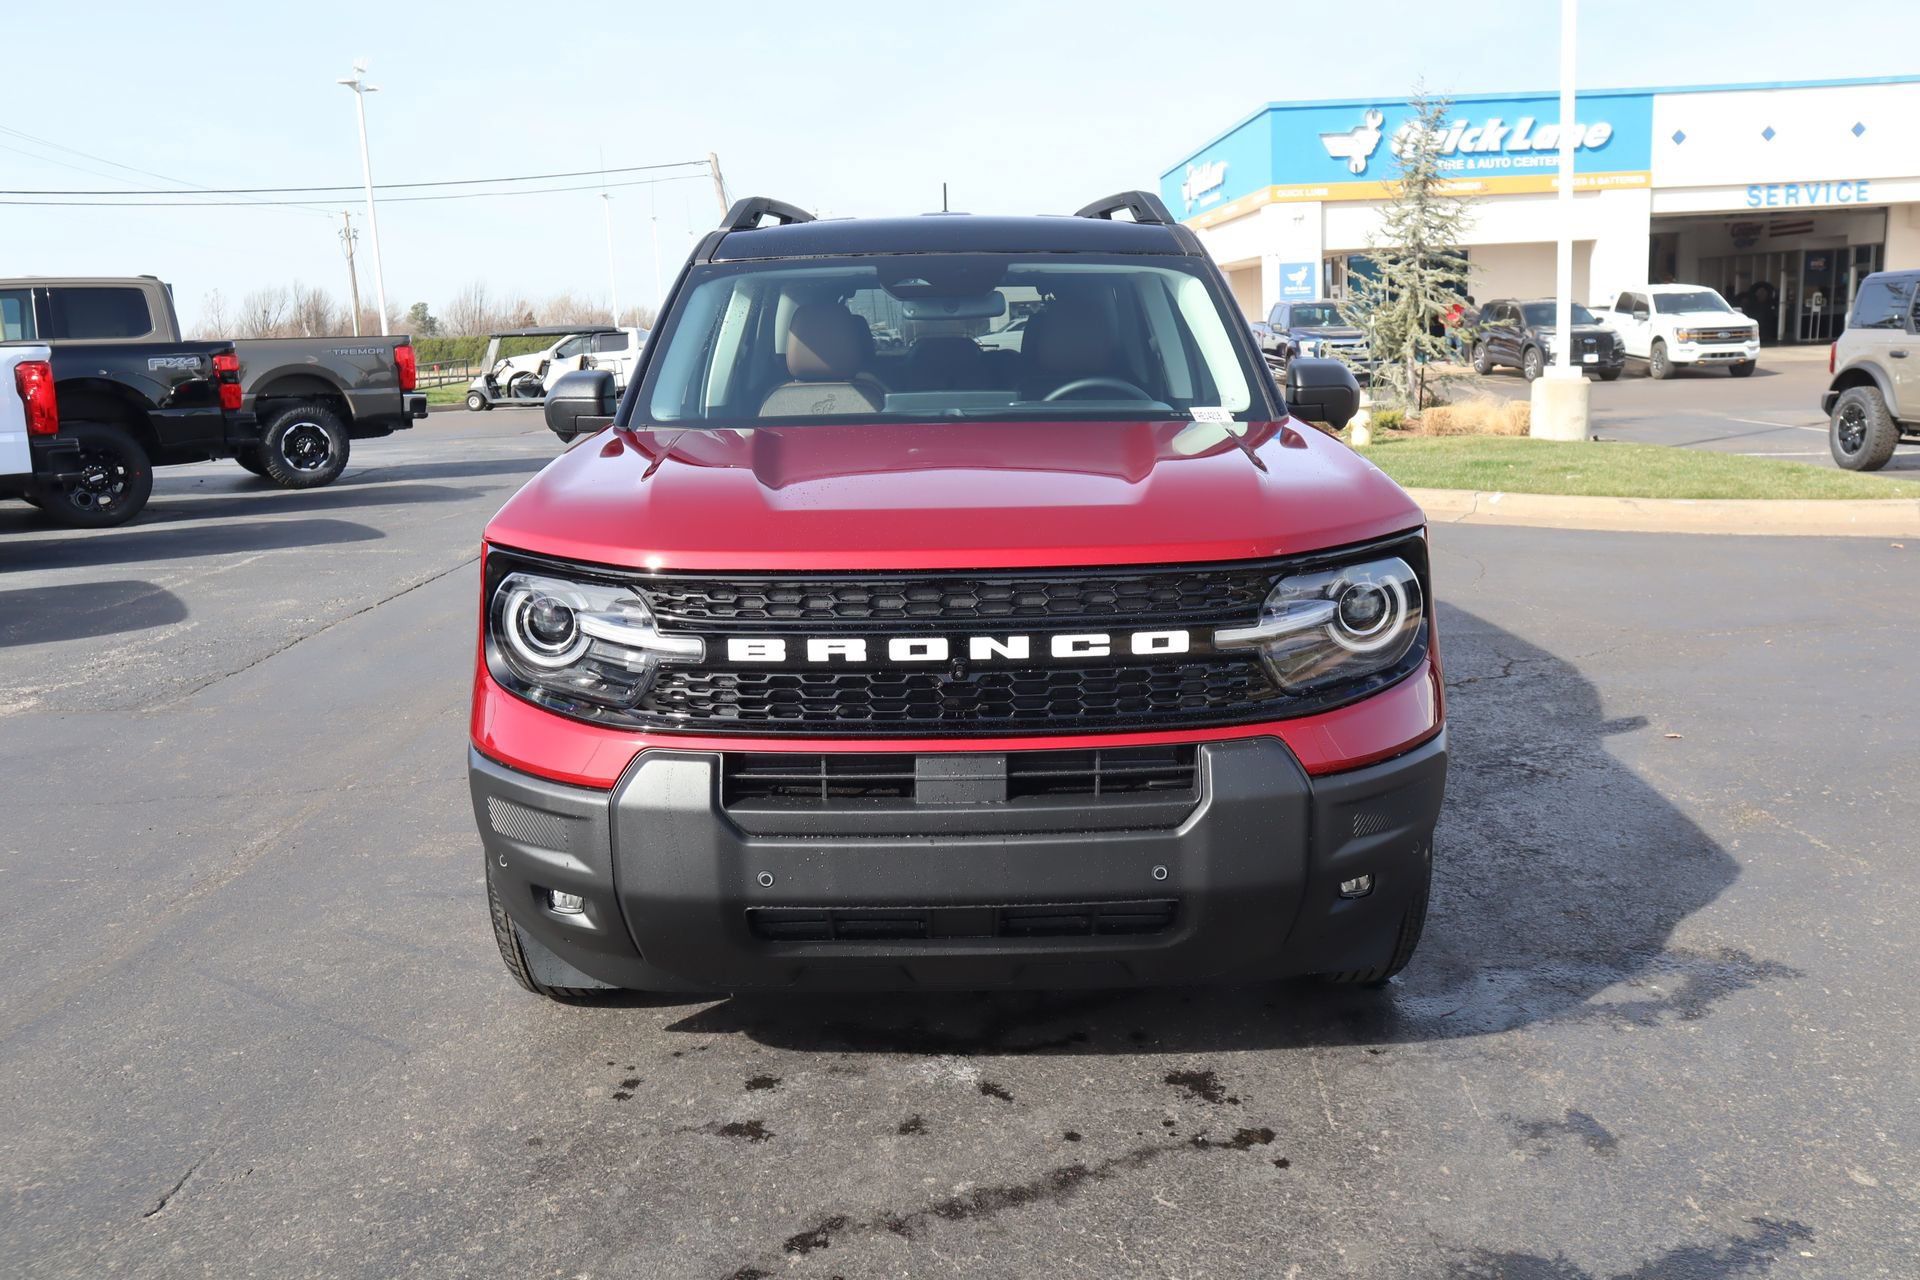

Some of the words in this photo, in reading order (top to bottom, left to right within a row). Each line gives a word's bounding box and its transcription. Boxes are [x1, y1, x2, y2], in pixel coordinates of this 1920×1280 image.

[1436, 159, 1464, 170] TIRE
[1467, 159, 1475, 169] &
[1477, 157, 1511, 169] AUTO
[1746, 181, 1870, 207] SERVICE
[335, 347, 385, 356] TREMOR
[148, 356, 201, 371] FX4
[727, 630, 1190, 662] BRONCO
